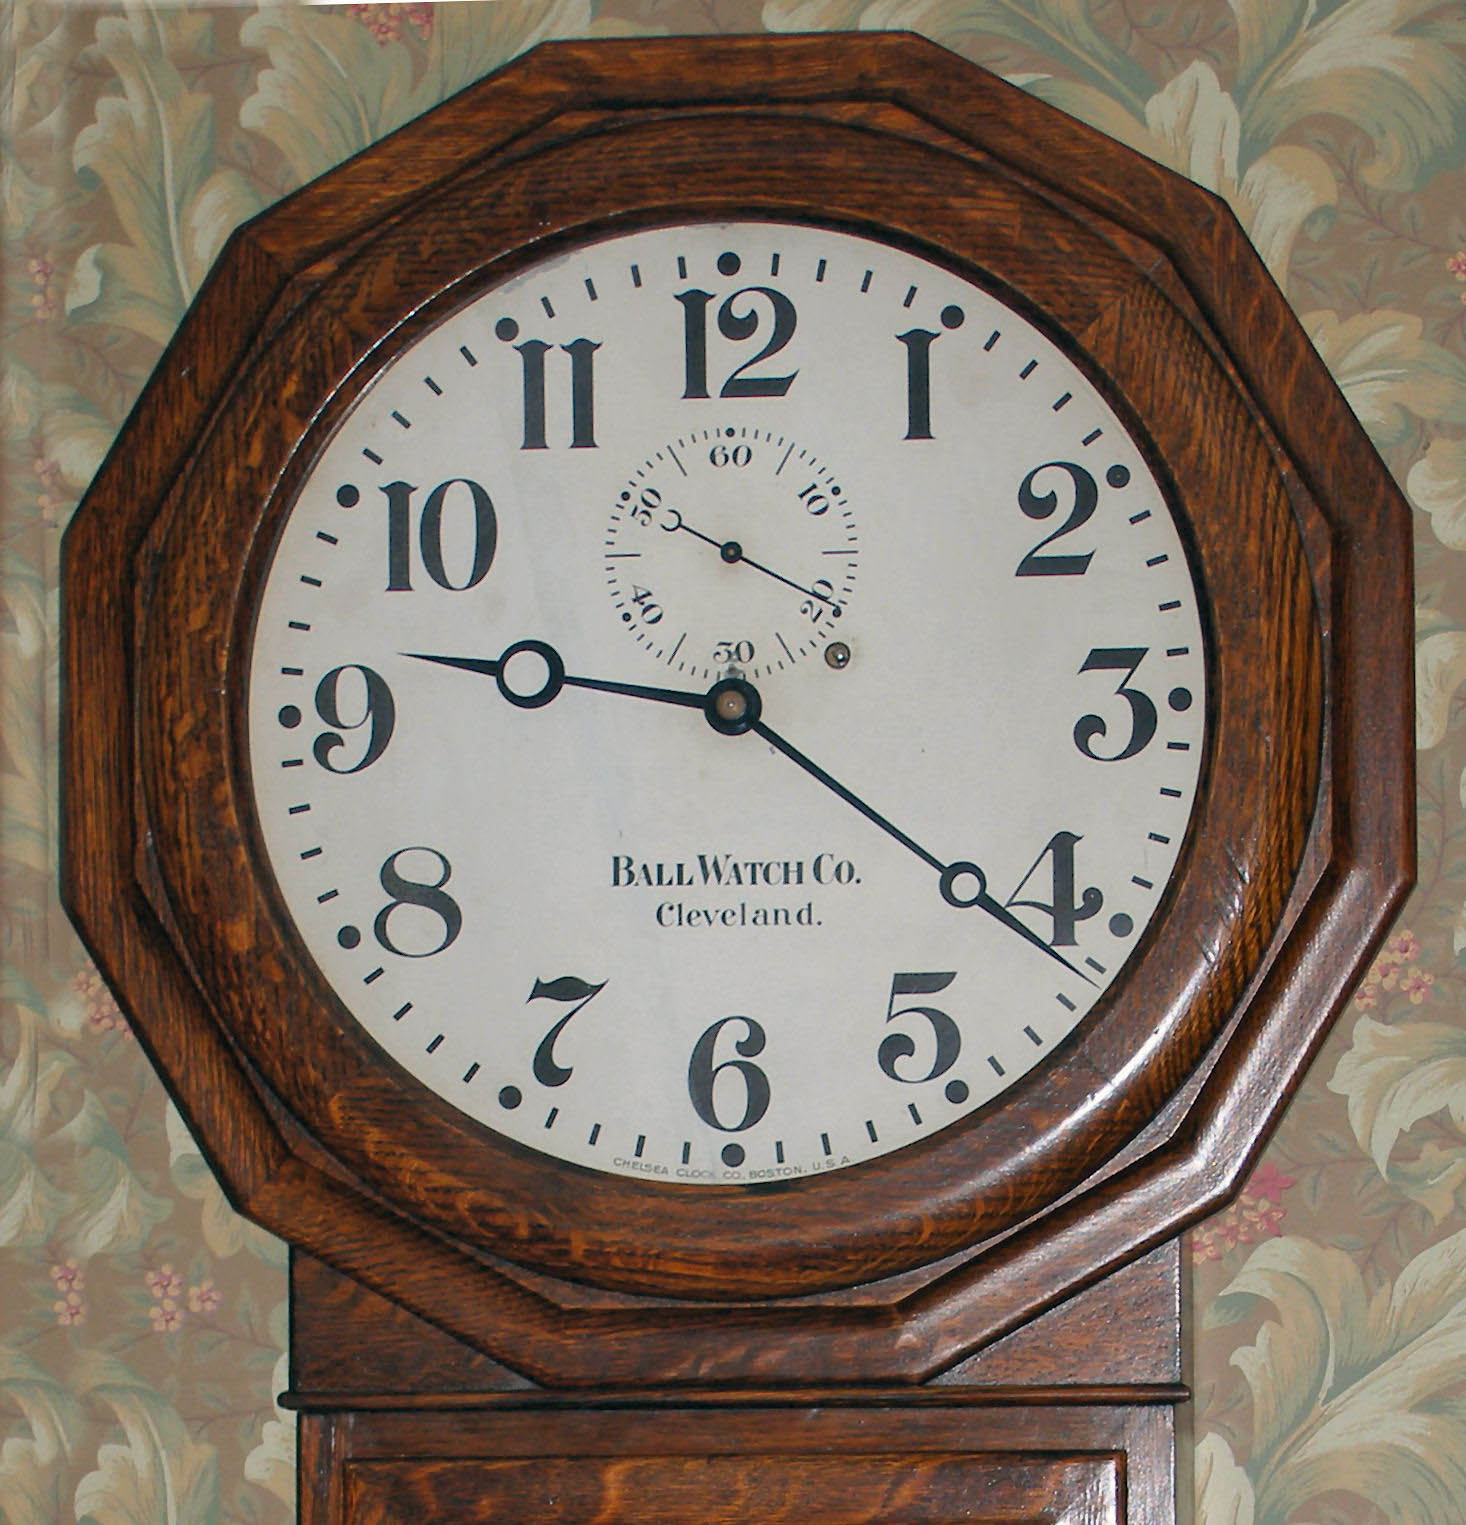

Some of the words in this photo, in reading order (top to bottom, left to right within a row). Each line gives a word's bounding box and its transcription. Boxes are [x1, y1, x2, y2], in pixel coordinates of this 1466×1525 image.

[513, 338, 603, 450] 11
[673, 286, 799, 399] 12
[894, 328, 942, 440] 1
[630, 487, 662, 527] 50
[709, 444, 752, 467] 60
[797, 482, 830, 515] 10
[377, 477, 498, 591] 10
[1015, 461, 1099, 577] 2
[631, 583, 664, 625] 40
[712, 640, 755, 664] 30
[799, 579, 834, 623] 20
[312, 664, 396, 775] 9
[1073, 647, 1158, 762] 3
[373, 846, 463, 958] 8
[610, 855, 694, 887] BALL
[696, 854, 804, 886] WATCH
[655, 901, 822, 928] Cleveland.
[1003, 830, 1104, 947] 4
[525, 975, 610, 1087] 7
[687, 1015, 771, 1133] 6
[877, 971, 962, 1084] 5
[613, 1157, 669, 1175] CHELSEA
